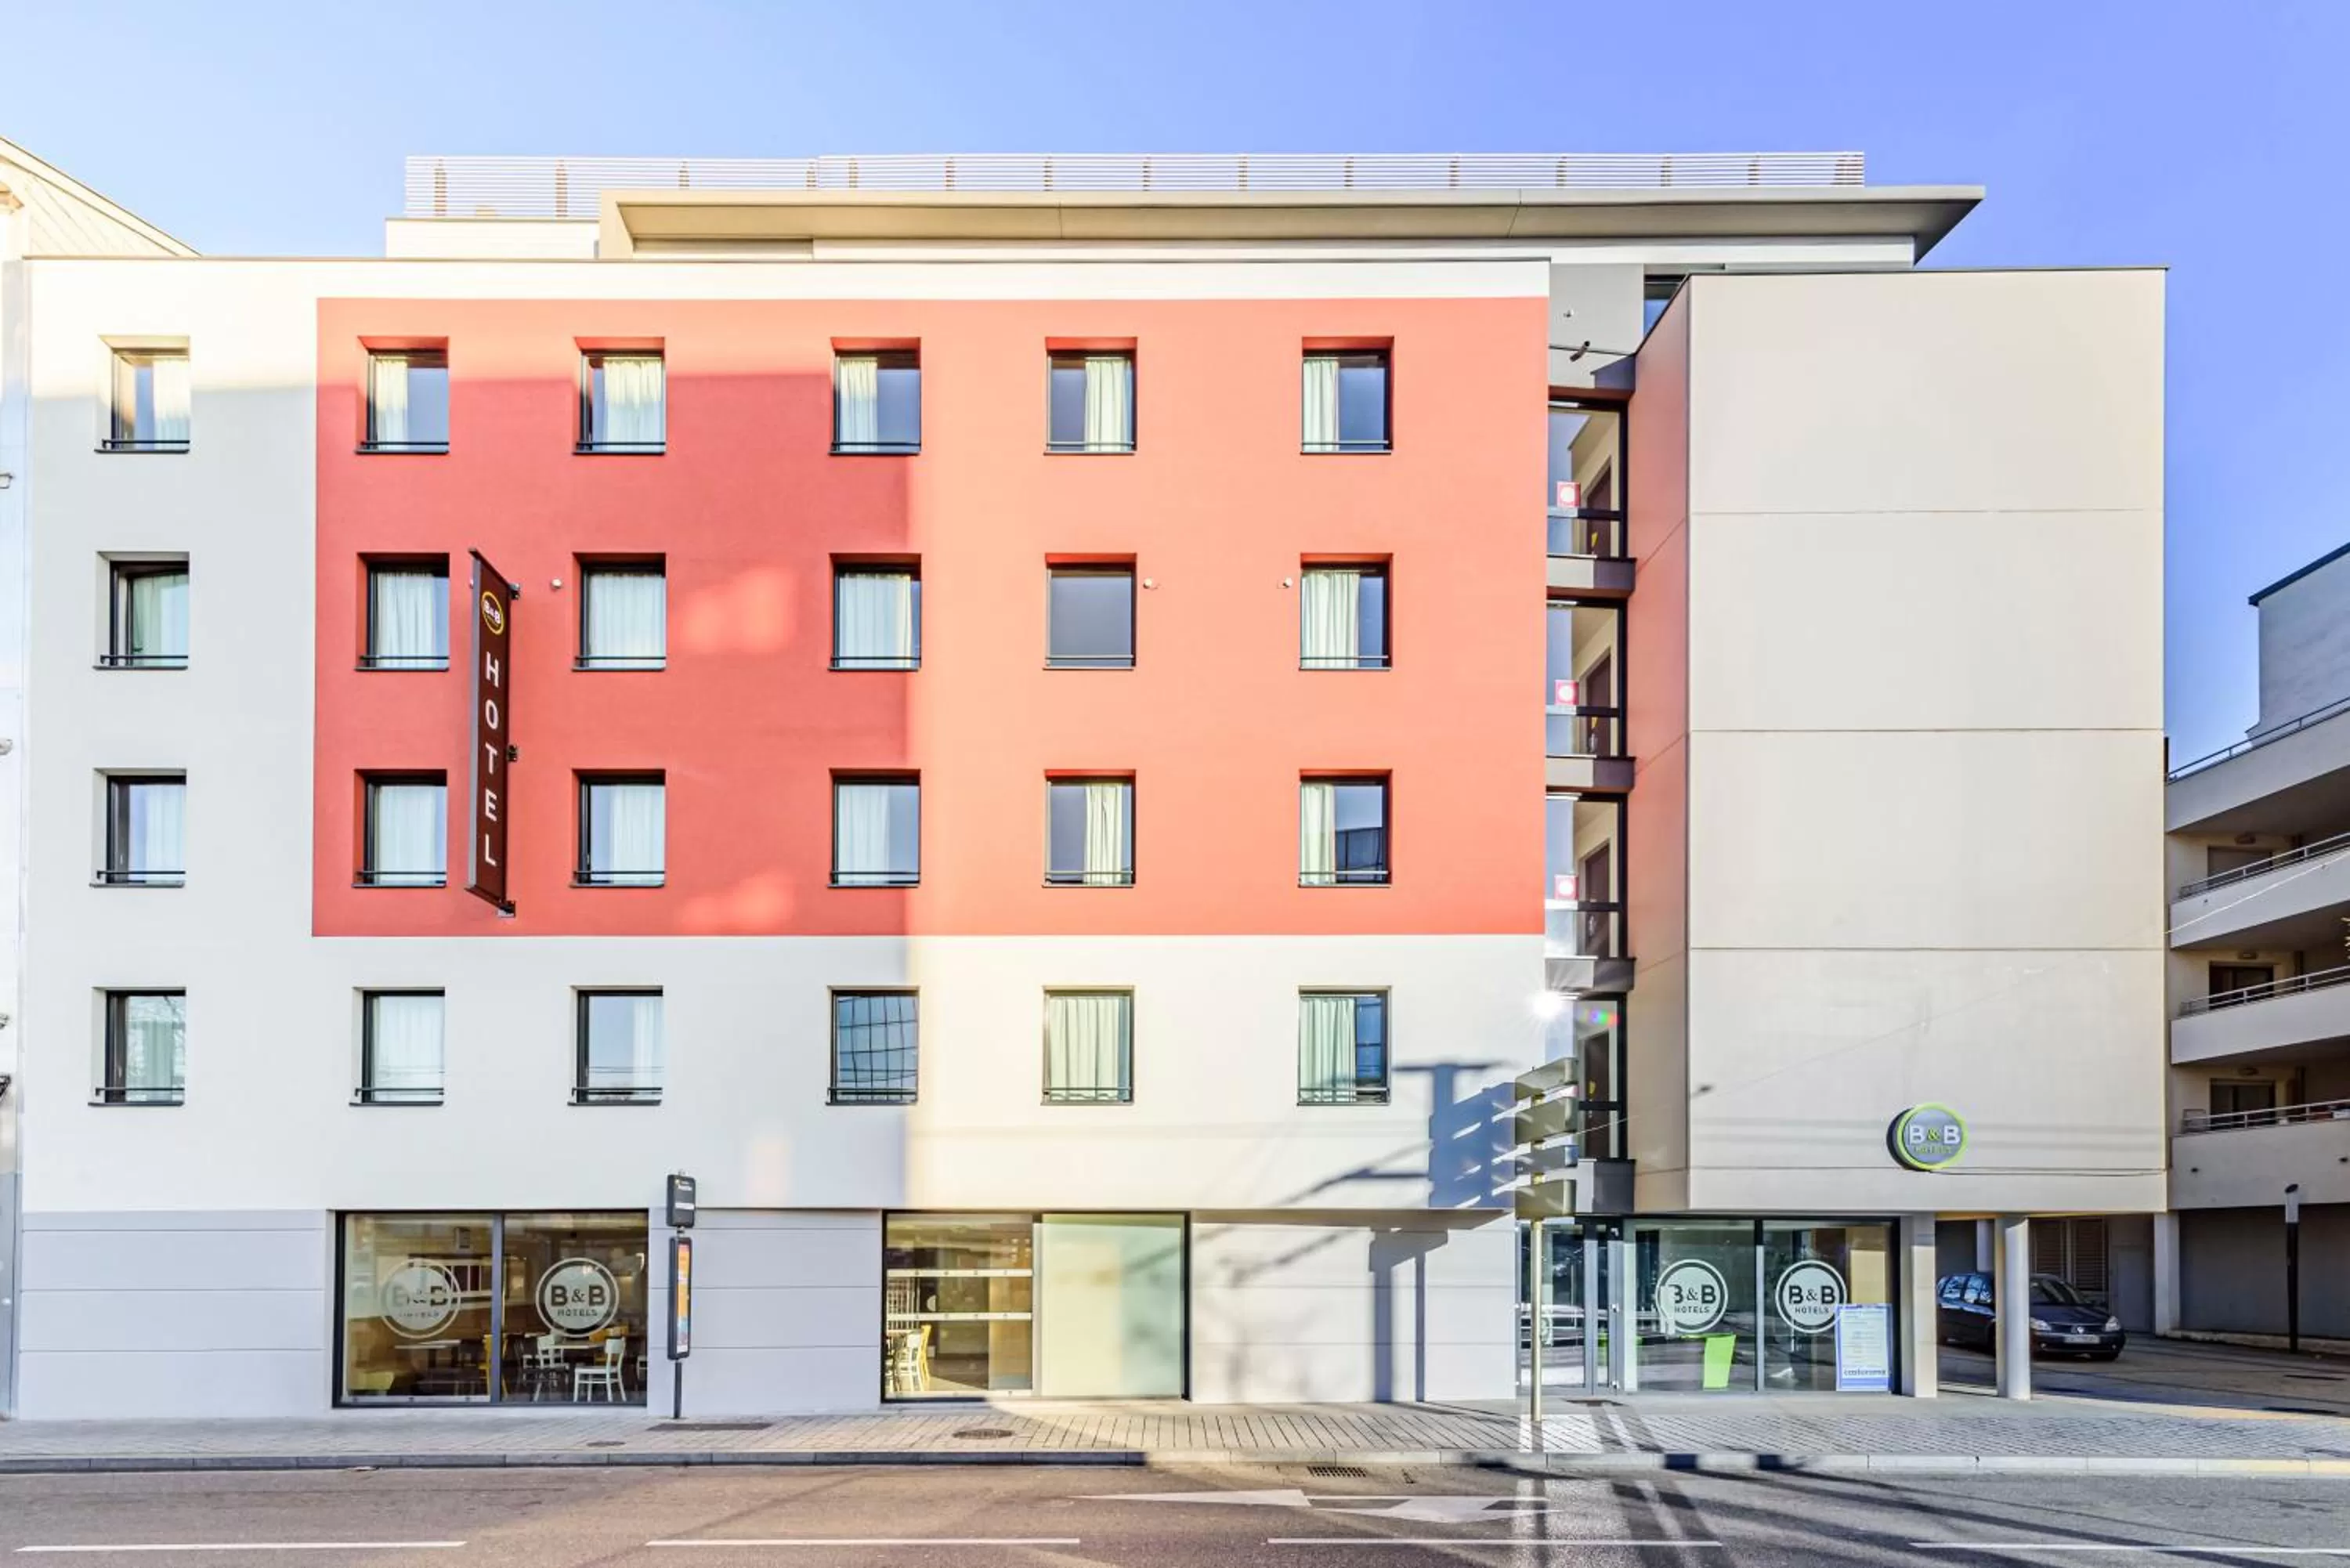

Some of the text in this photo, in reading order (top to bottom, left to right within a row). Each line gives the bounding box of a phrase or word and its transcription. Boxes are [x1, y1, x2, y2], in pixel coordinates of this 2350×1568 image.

[484, 651, 500, 867] HOTEL
[1909, 1125, 1961, 1144] B&B
[551, 1285, 606, 1306] B&B
[1788, 1285, 1836, 1305] B&B
[1795, 1306, 1830, 1314] HOTELS
